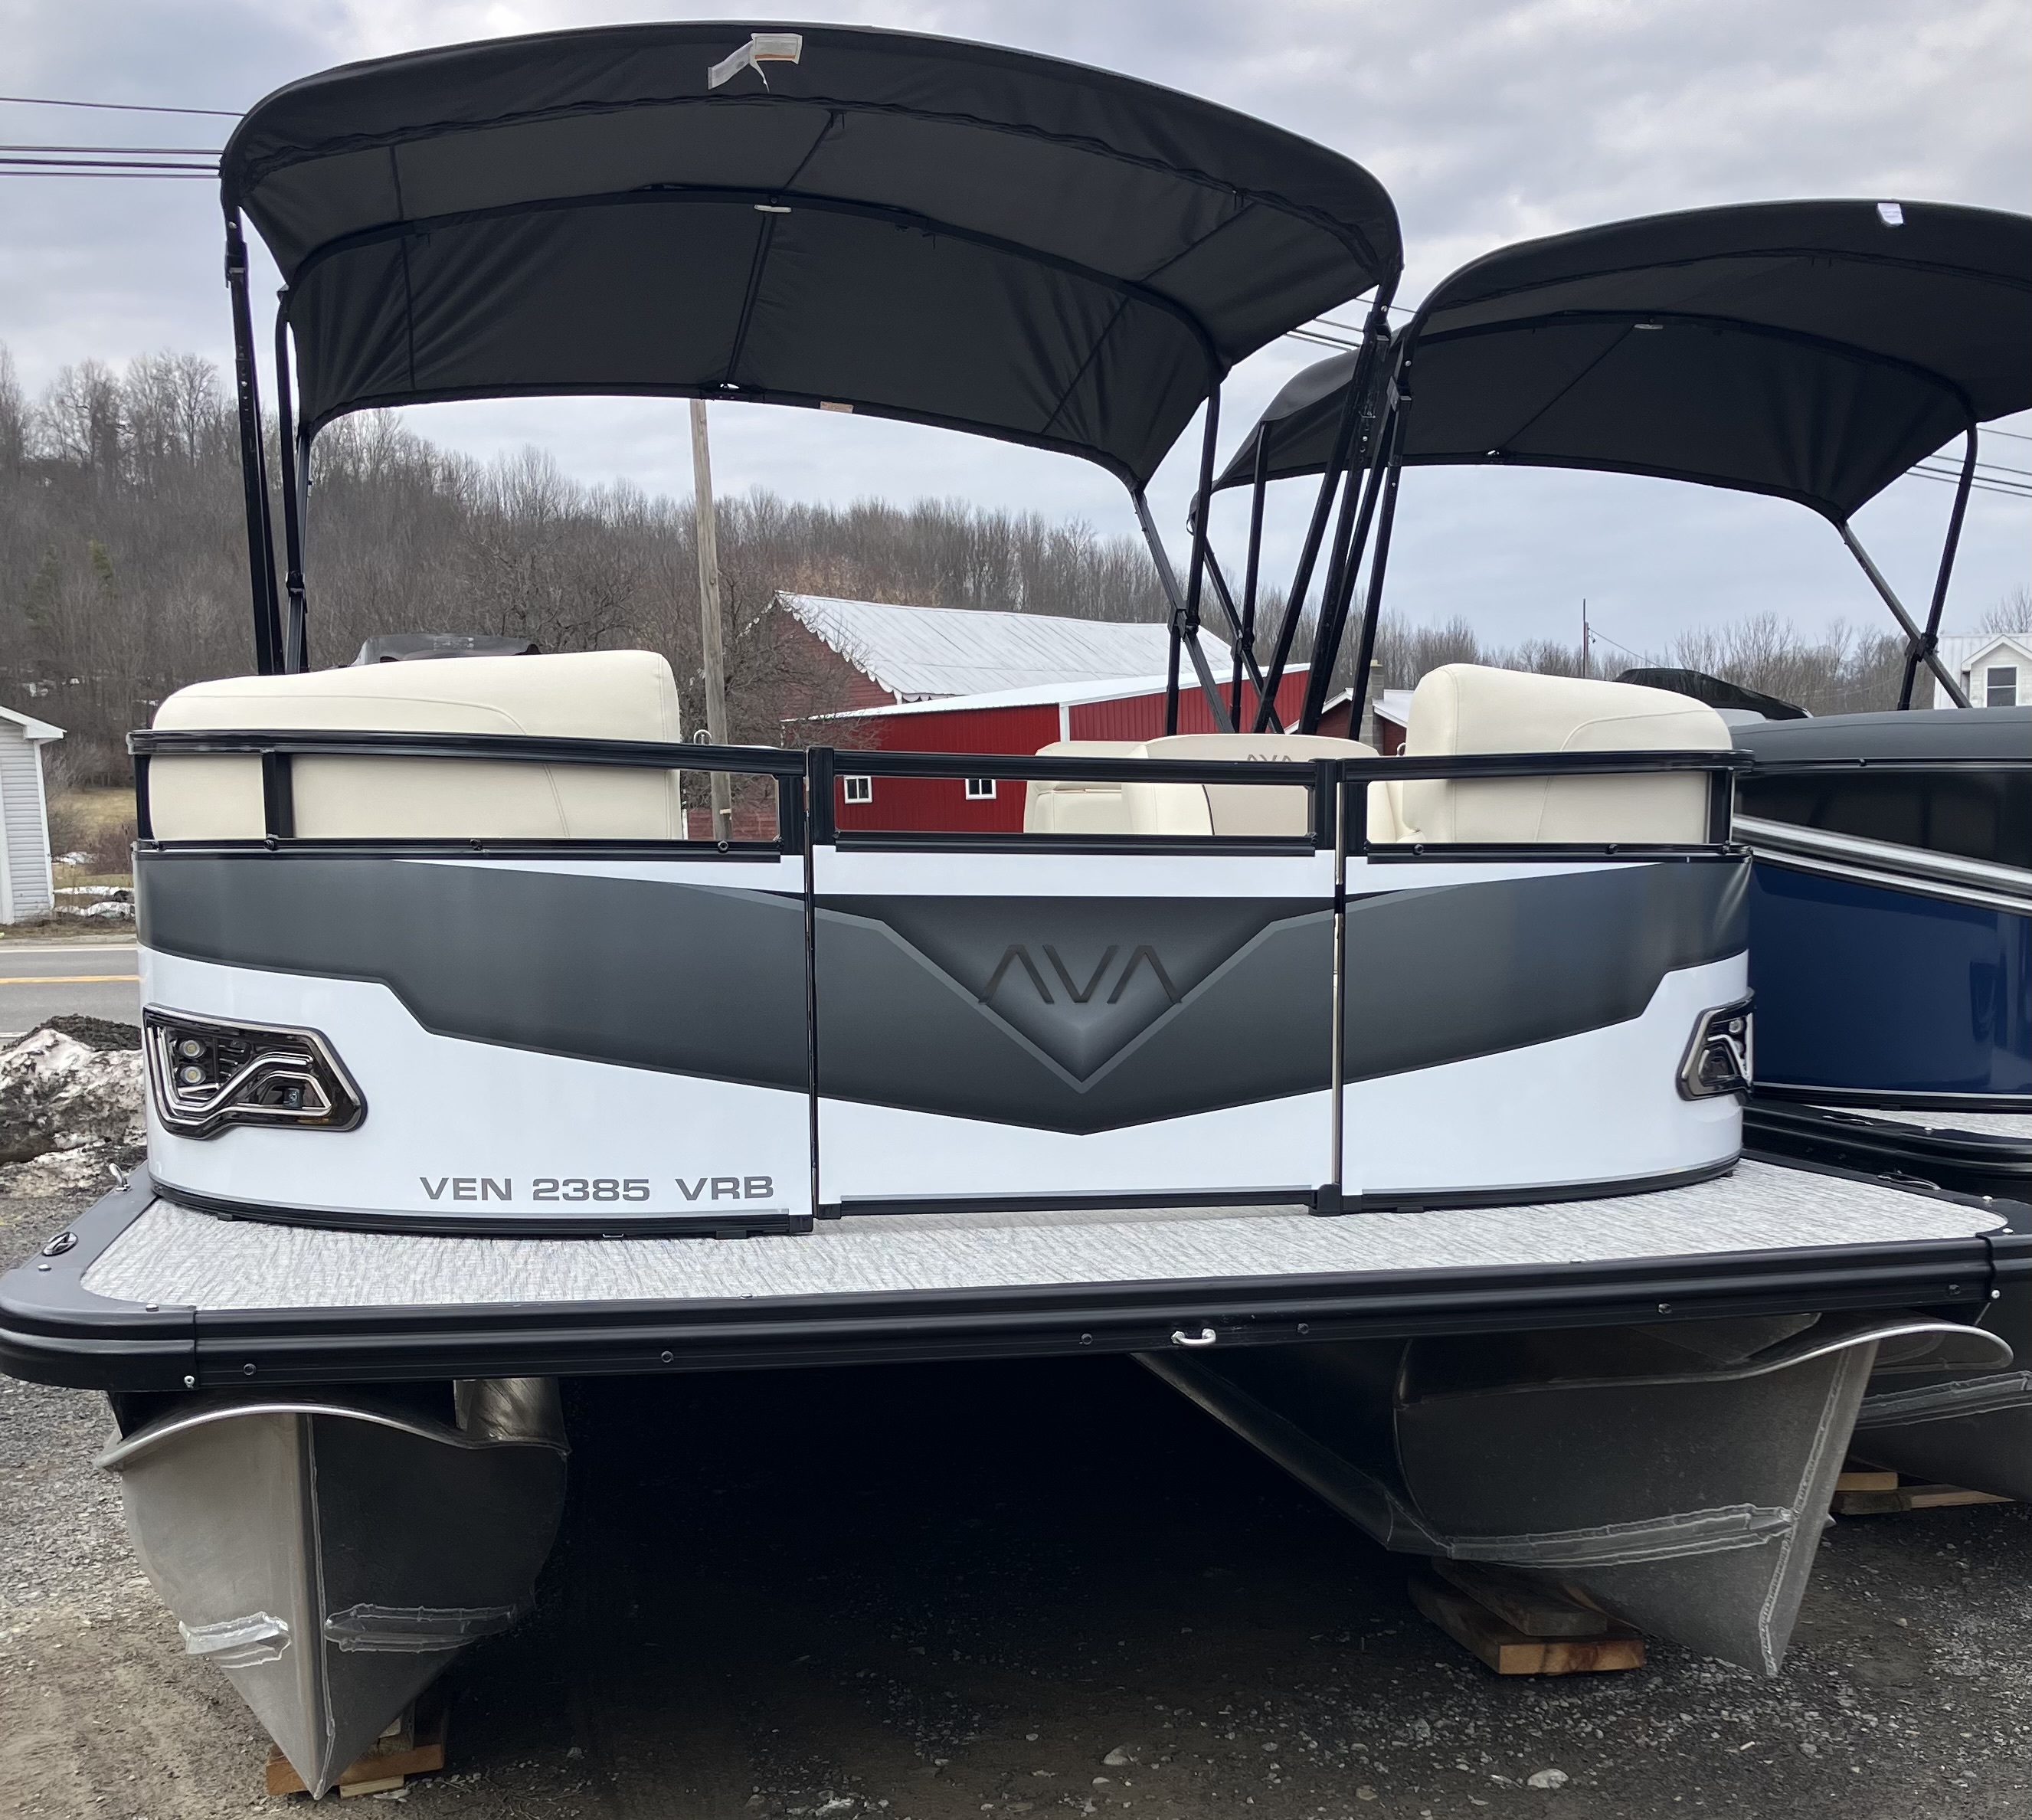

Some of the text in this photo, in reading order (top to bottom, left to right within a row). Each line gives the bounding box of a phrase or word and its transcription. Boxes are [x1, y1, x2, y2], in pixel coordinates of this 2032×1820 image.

[978, 944, 1183, 1005] AVA
[419, 1175, 775, 1202] VEN 2385 VRB
